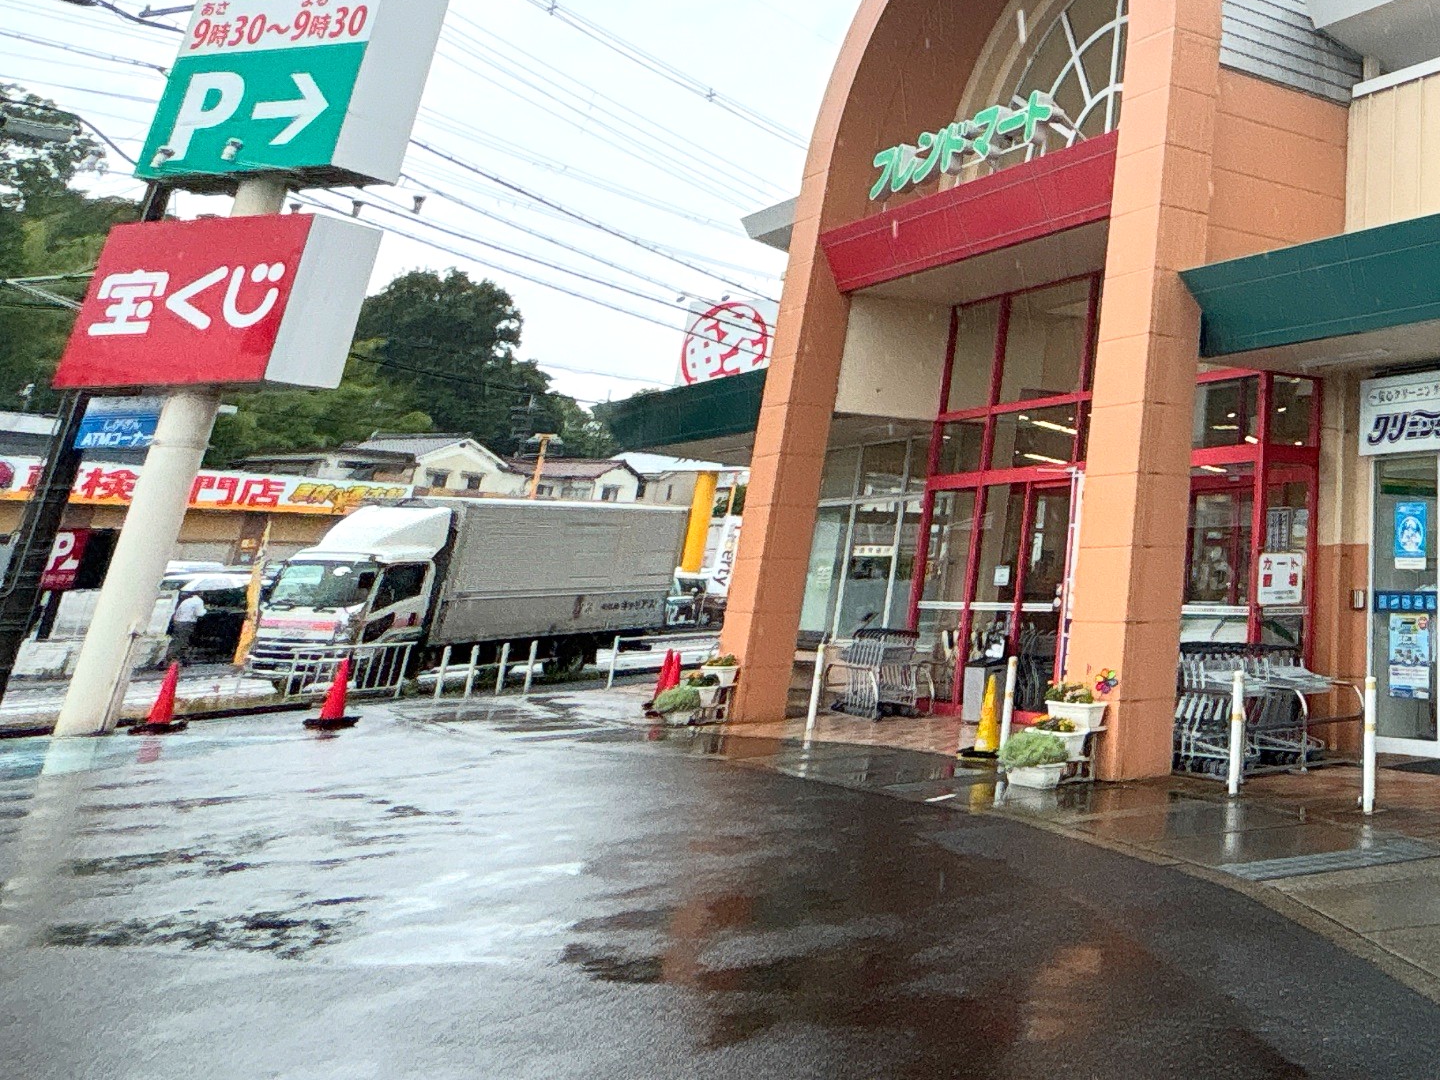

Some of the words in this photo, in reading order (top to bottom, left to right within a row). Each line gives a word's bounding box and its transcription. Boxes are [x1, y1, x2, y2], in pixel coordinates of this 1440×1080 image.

[201, 1, 230, 16] あさ
[166, 71, 246, 161] P
[869, 90, 1054, 201] フレンドマート
[88, 262, 287, 337] 宝くじ
[81, 431, 155, 448] ATMコーナー
[50, 531, 76, 572] P
